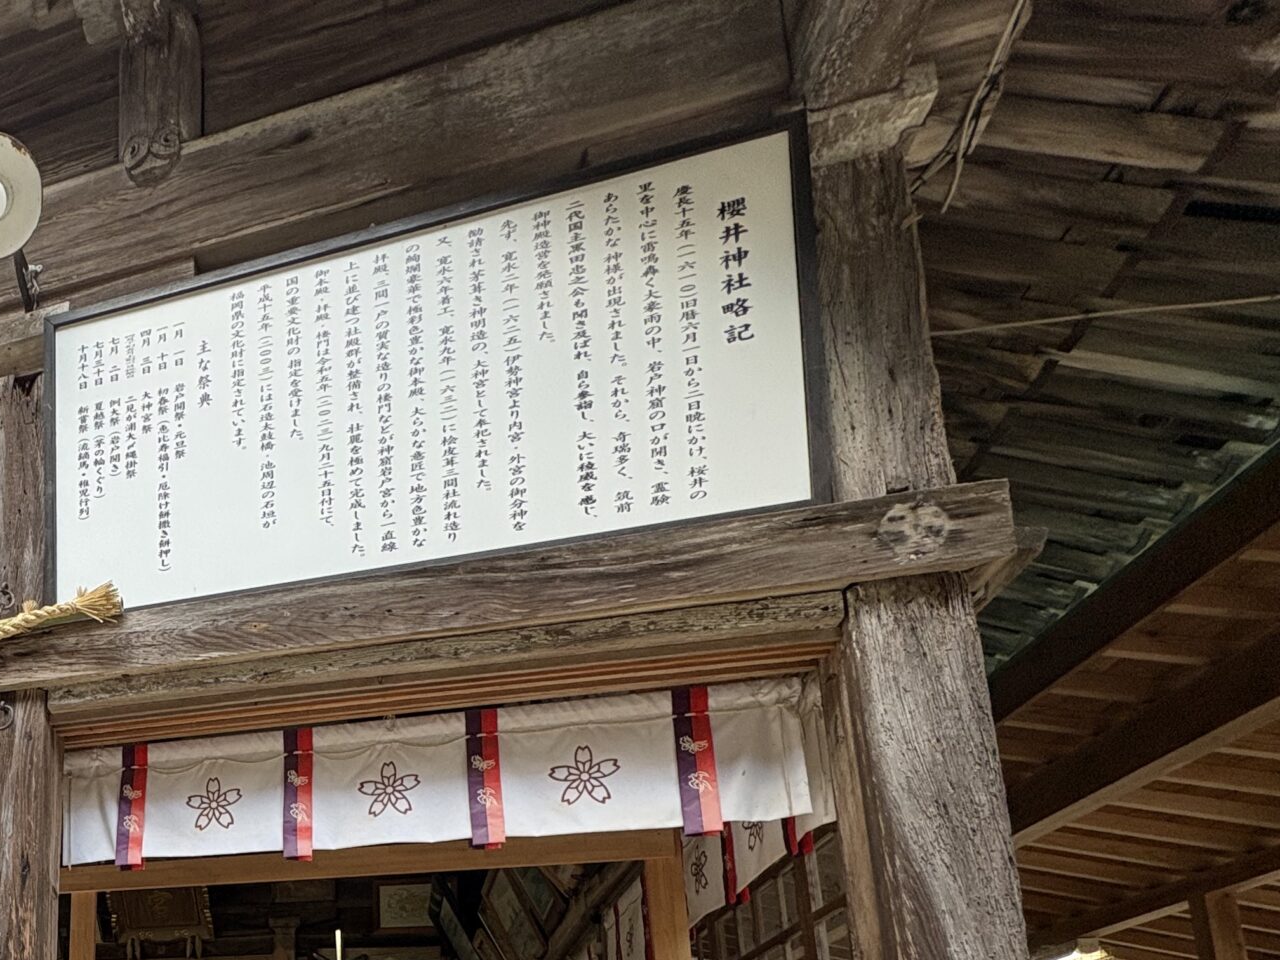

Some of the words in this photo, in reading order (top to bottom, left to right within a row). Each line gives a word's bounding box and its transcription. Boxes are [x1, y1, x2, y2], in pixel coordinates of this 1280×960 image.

[716, 197, 755, 344] 櫻井神社略記
[197, 340, 213, 408] 主な祭典
